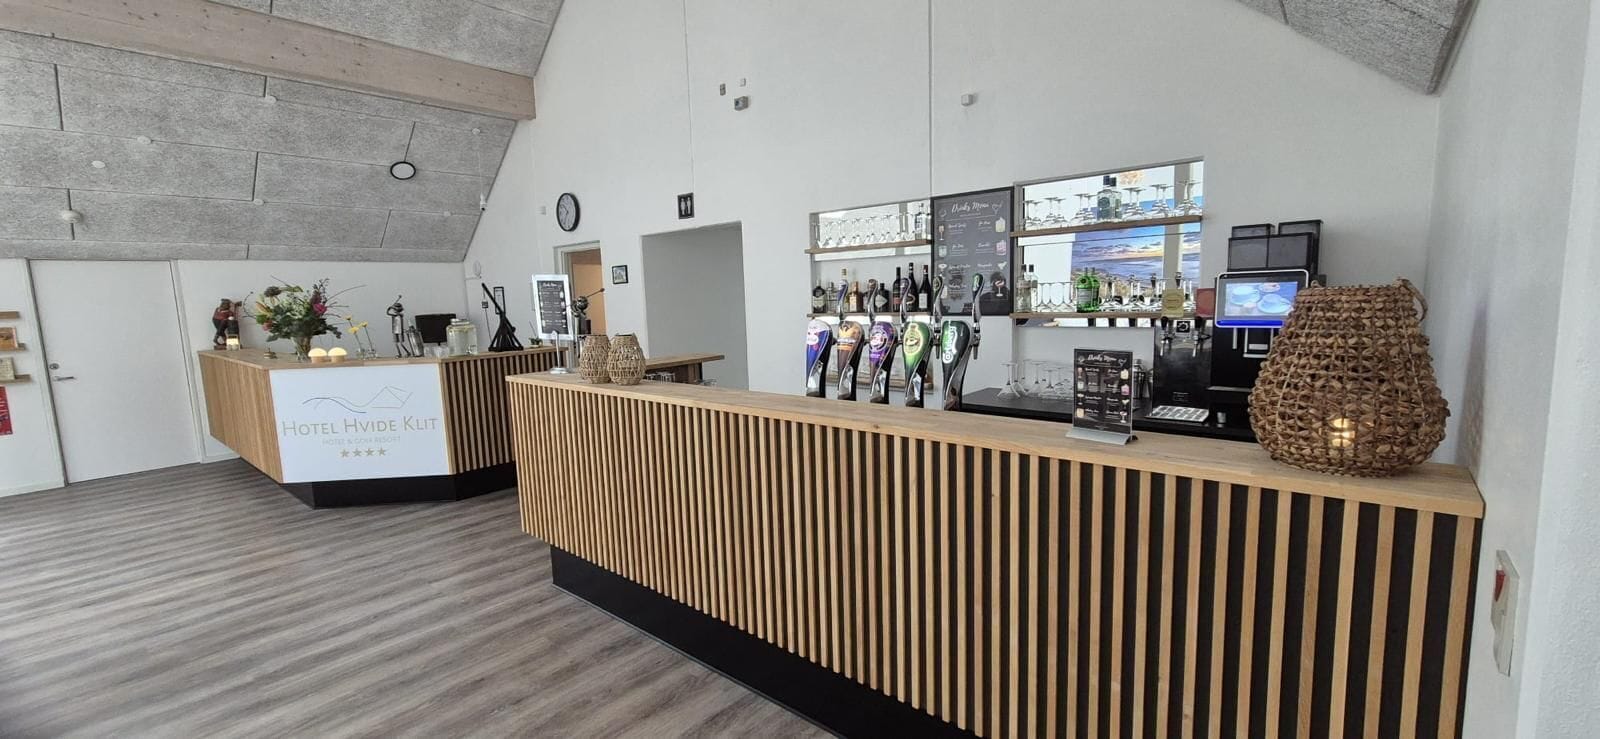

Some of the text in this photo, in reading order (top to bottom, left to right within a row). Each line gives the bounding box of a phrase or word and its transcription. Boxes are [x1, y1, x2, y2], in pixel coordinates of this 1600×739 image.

[282, 415, 439, 437] HOTEL HVIDE KLIT
